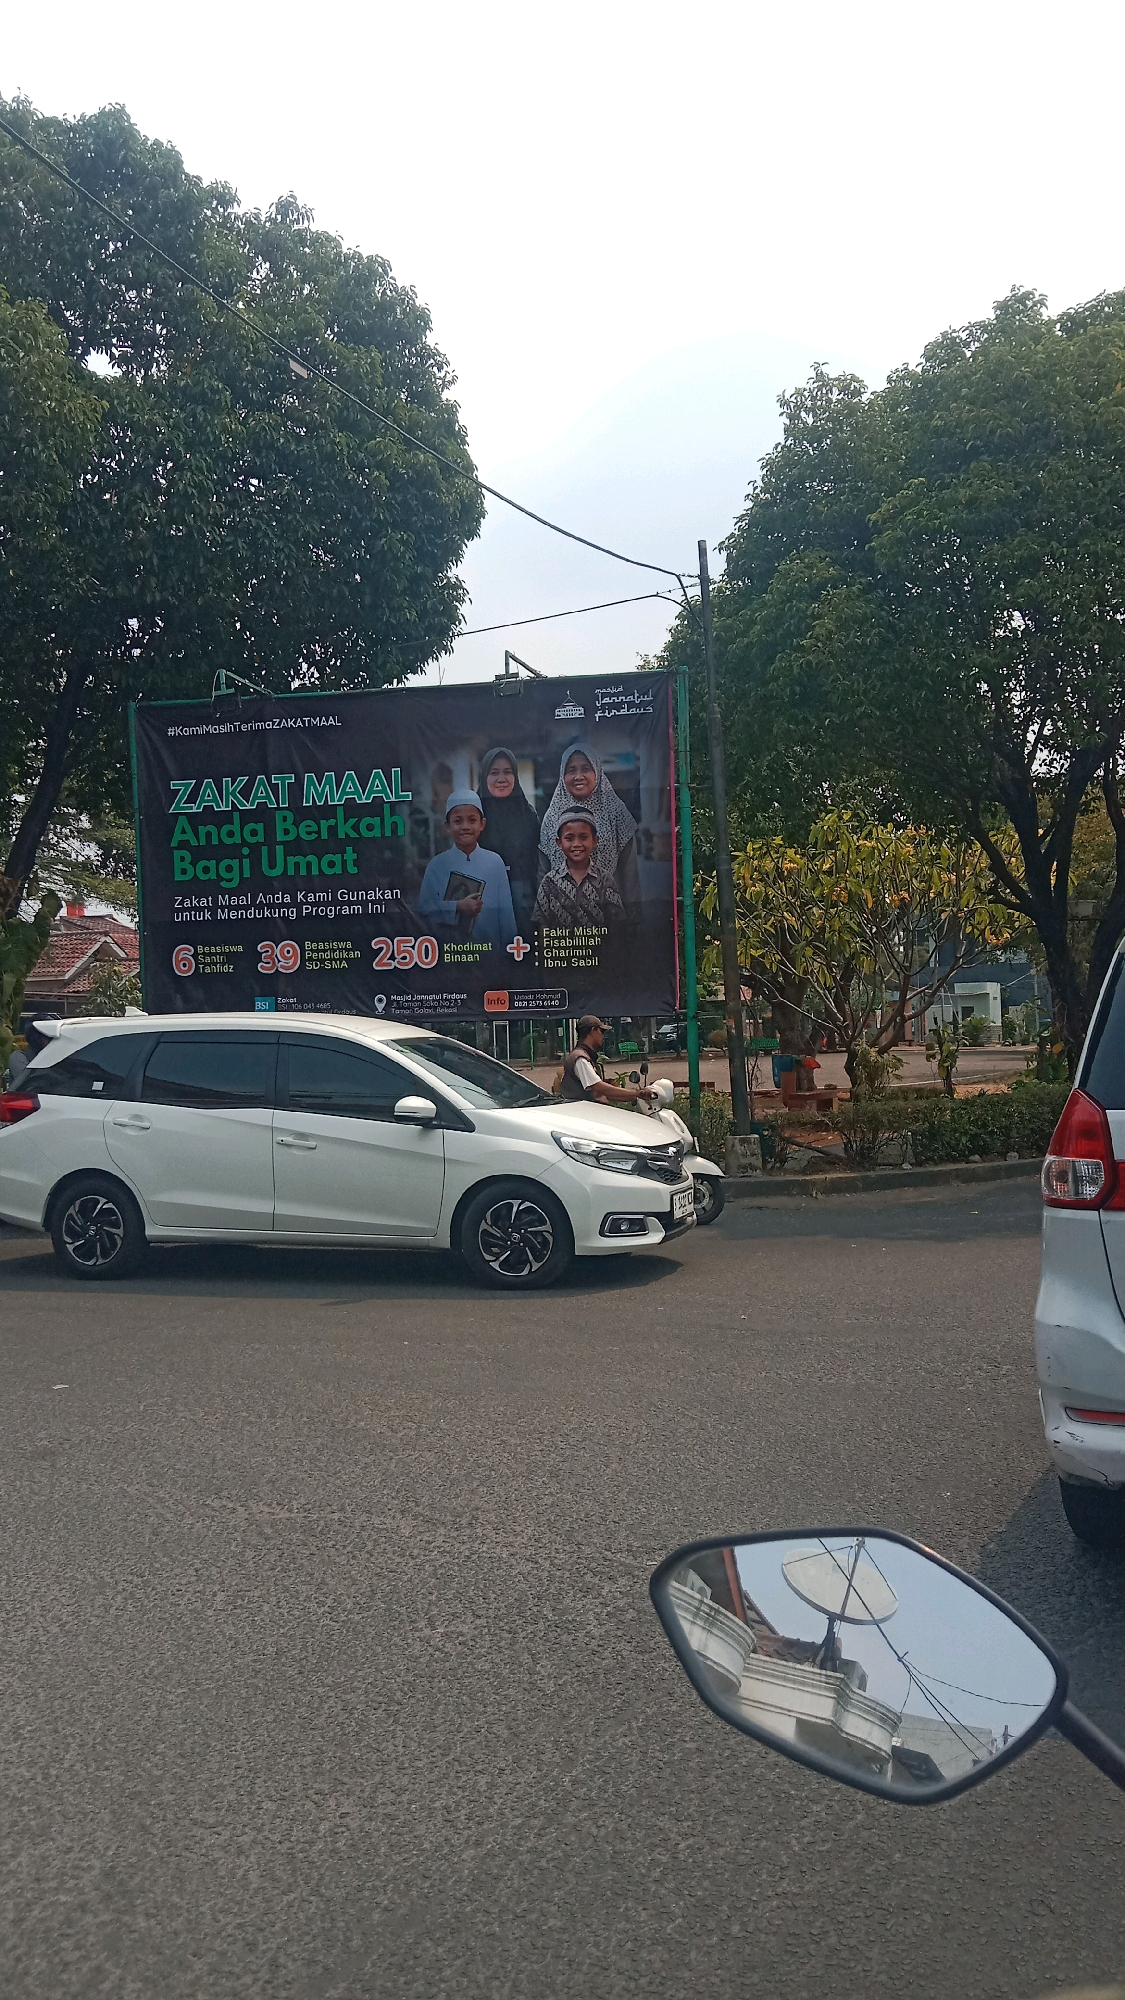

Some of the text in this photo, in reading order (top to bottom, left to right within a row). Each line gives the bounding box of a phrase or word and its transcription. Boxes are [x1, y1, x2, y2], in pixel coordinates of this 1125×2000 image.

[167, 715, 342, 736] #KamiMasihTerimaZAKATMAAL
[168, 768, 412, 813] ZAKAT MAAL
[170, 804, 405, 847] Anda Berkah
[173, 845, 358, 889] Bagi Umat
[174, 887, 401, 908] Zakat Maal Anda Kami Gunakan
[174, 902, 386, 922] untuk Mendukung Program Ini
[543, 926, 608, 938] Fakir Miskin
[304, 940, 352, 950] Beasiswa
[443, 942, 492, 952] Khodimat
[543, 936, 602, 947] Fisabilillah
[197, 944, 244, 953] Beasiswa
[371, 935, 439, 970] 250
[543, 947, 592, 958] Gharimin
[198, 954, 227, 964] Santri
[257, 940, 301, 974] 39
[305, 949, 361, 960] Pendidikan
[444, 953, 480, 962] Binaan
[172, 944, 196, 977] 6
[305, 960, 348, 969] SD-SMA
[544, 957, 599, 968] Ibnu Sabil
[198, 964, 234, 973] Tahfidz
[255, 1001, 269, 1010] BSI
[487, 997, 506, 1005] Info
